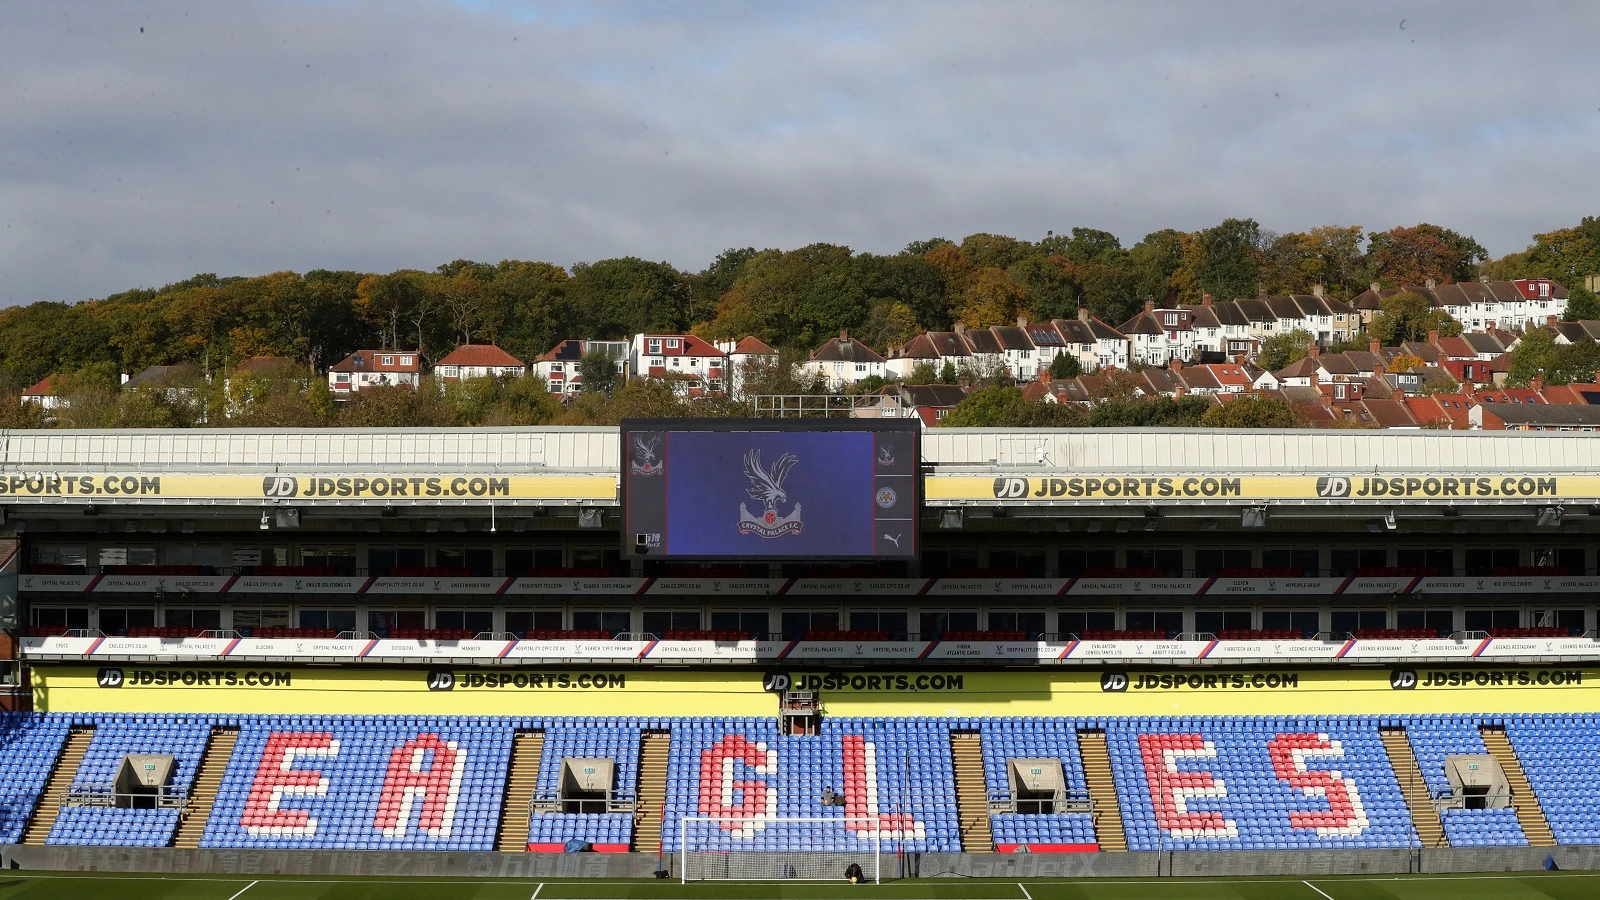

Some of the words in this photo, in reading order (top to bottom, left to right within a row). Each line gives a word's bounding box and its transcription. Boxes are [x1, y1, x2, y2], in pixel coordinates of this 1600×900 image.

[267, 477, 294, 496] JD
[303, 478, 510, 496] JDSPORTS.COM
[998, 478, 1025, 497] JD
[1034, 478, 1240, 497] JDSPORTS.COM
[1320, 477, 1347, 496] JD
[1356, 478, 1556, 496] JDSPORTS.COM
[742, 522, 766, 535] CRYSTAL
[767, 525, 788, 536] PALACE
[100, 670, 122, 686] JD
[128, 670, 291, 686] JDSPORTS.COM
[430, 673, 452, 688] JD
[460, 673, 625, 689] JDSPORTS.COM
[766, 674, 788, 690] JD
[796, 674, 963, 690] JDSPORTS.COM
[1104, 674, 1126, 690] JD
[1133, 674, 1298, 690] JDSPORTS.COM
[1393, 672, 1414, 688] JD
[1422, 670, 1582, 687] JDSPORTS.COM
[241, 732, 1369, 838] EAGLES
[498, 853, 611, 877] 万博体育
